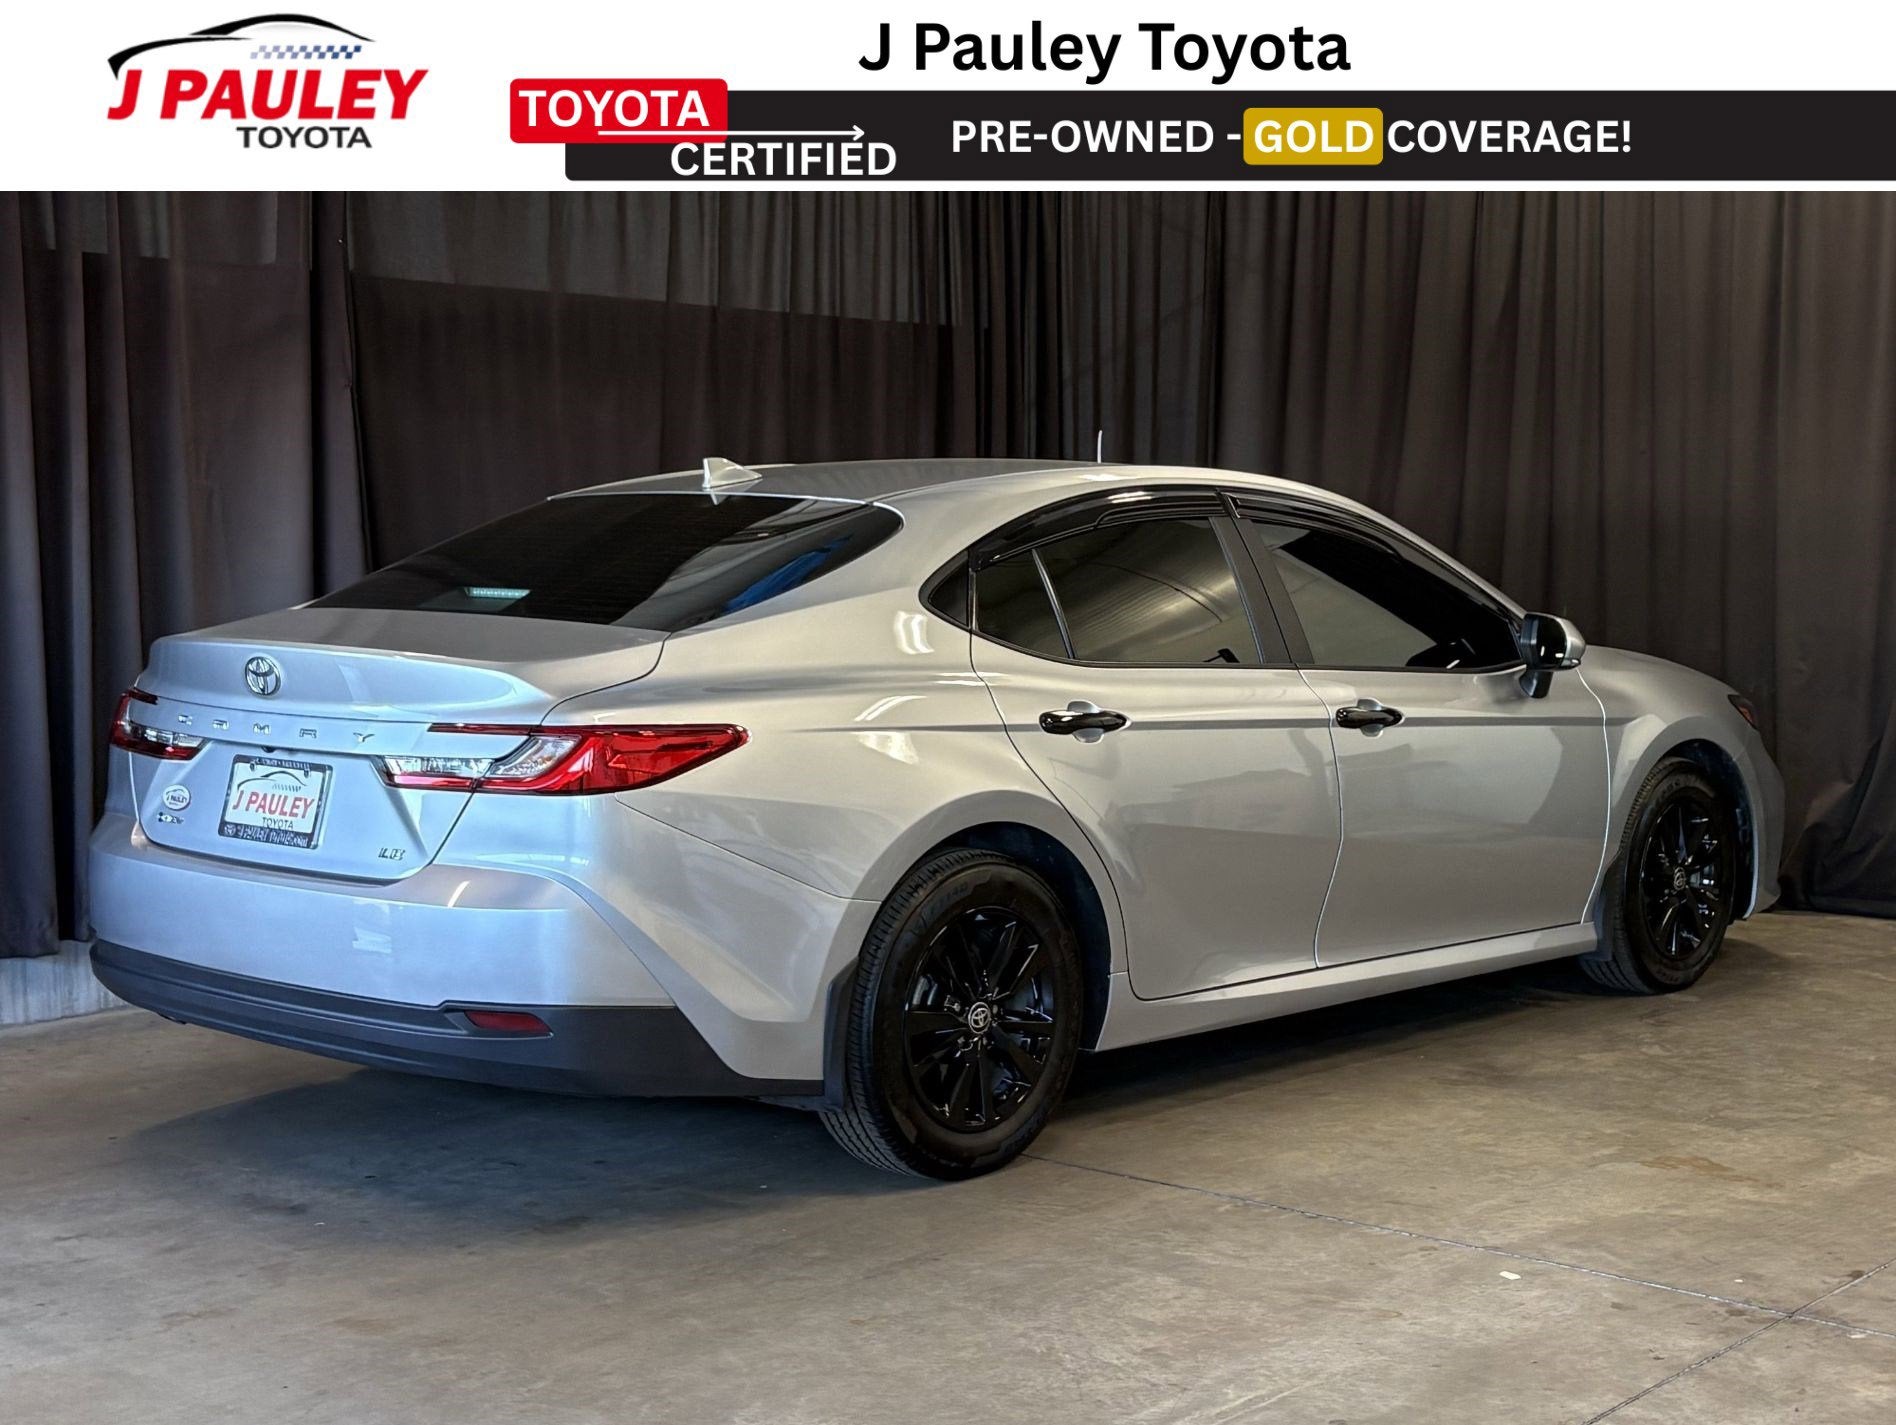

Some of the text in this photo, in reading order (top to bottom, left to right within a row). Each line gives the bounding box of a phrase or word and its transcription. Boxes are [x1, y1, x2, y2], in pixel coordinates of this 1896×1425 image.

[232, 790, 315, 819] J PAULEY
[262, 816, 294, 830] TOYOTA
